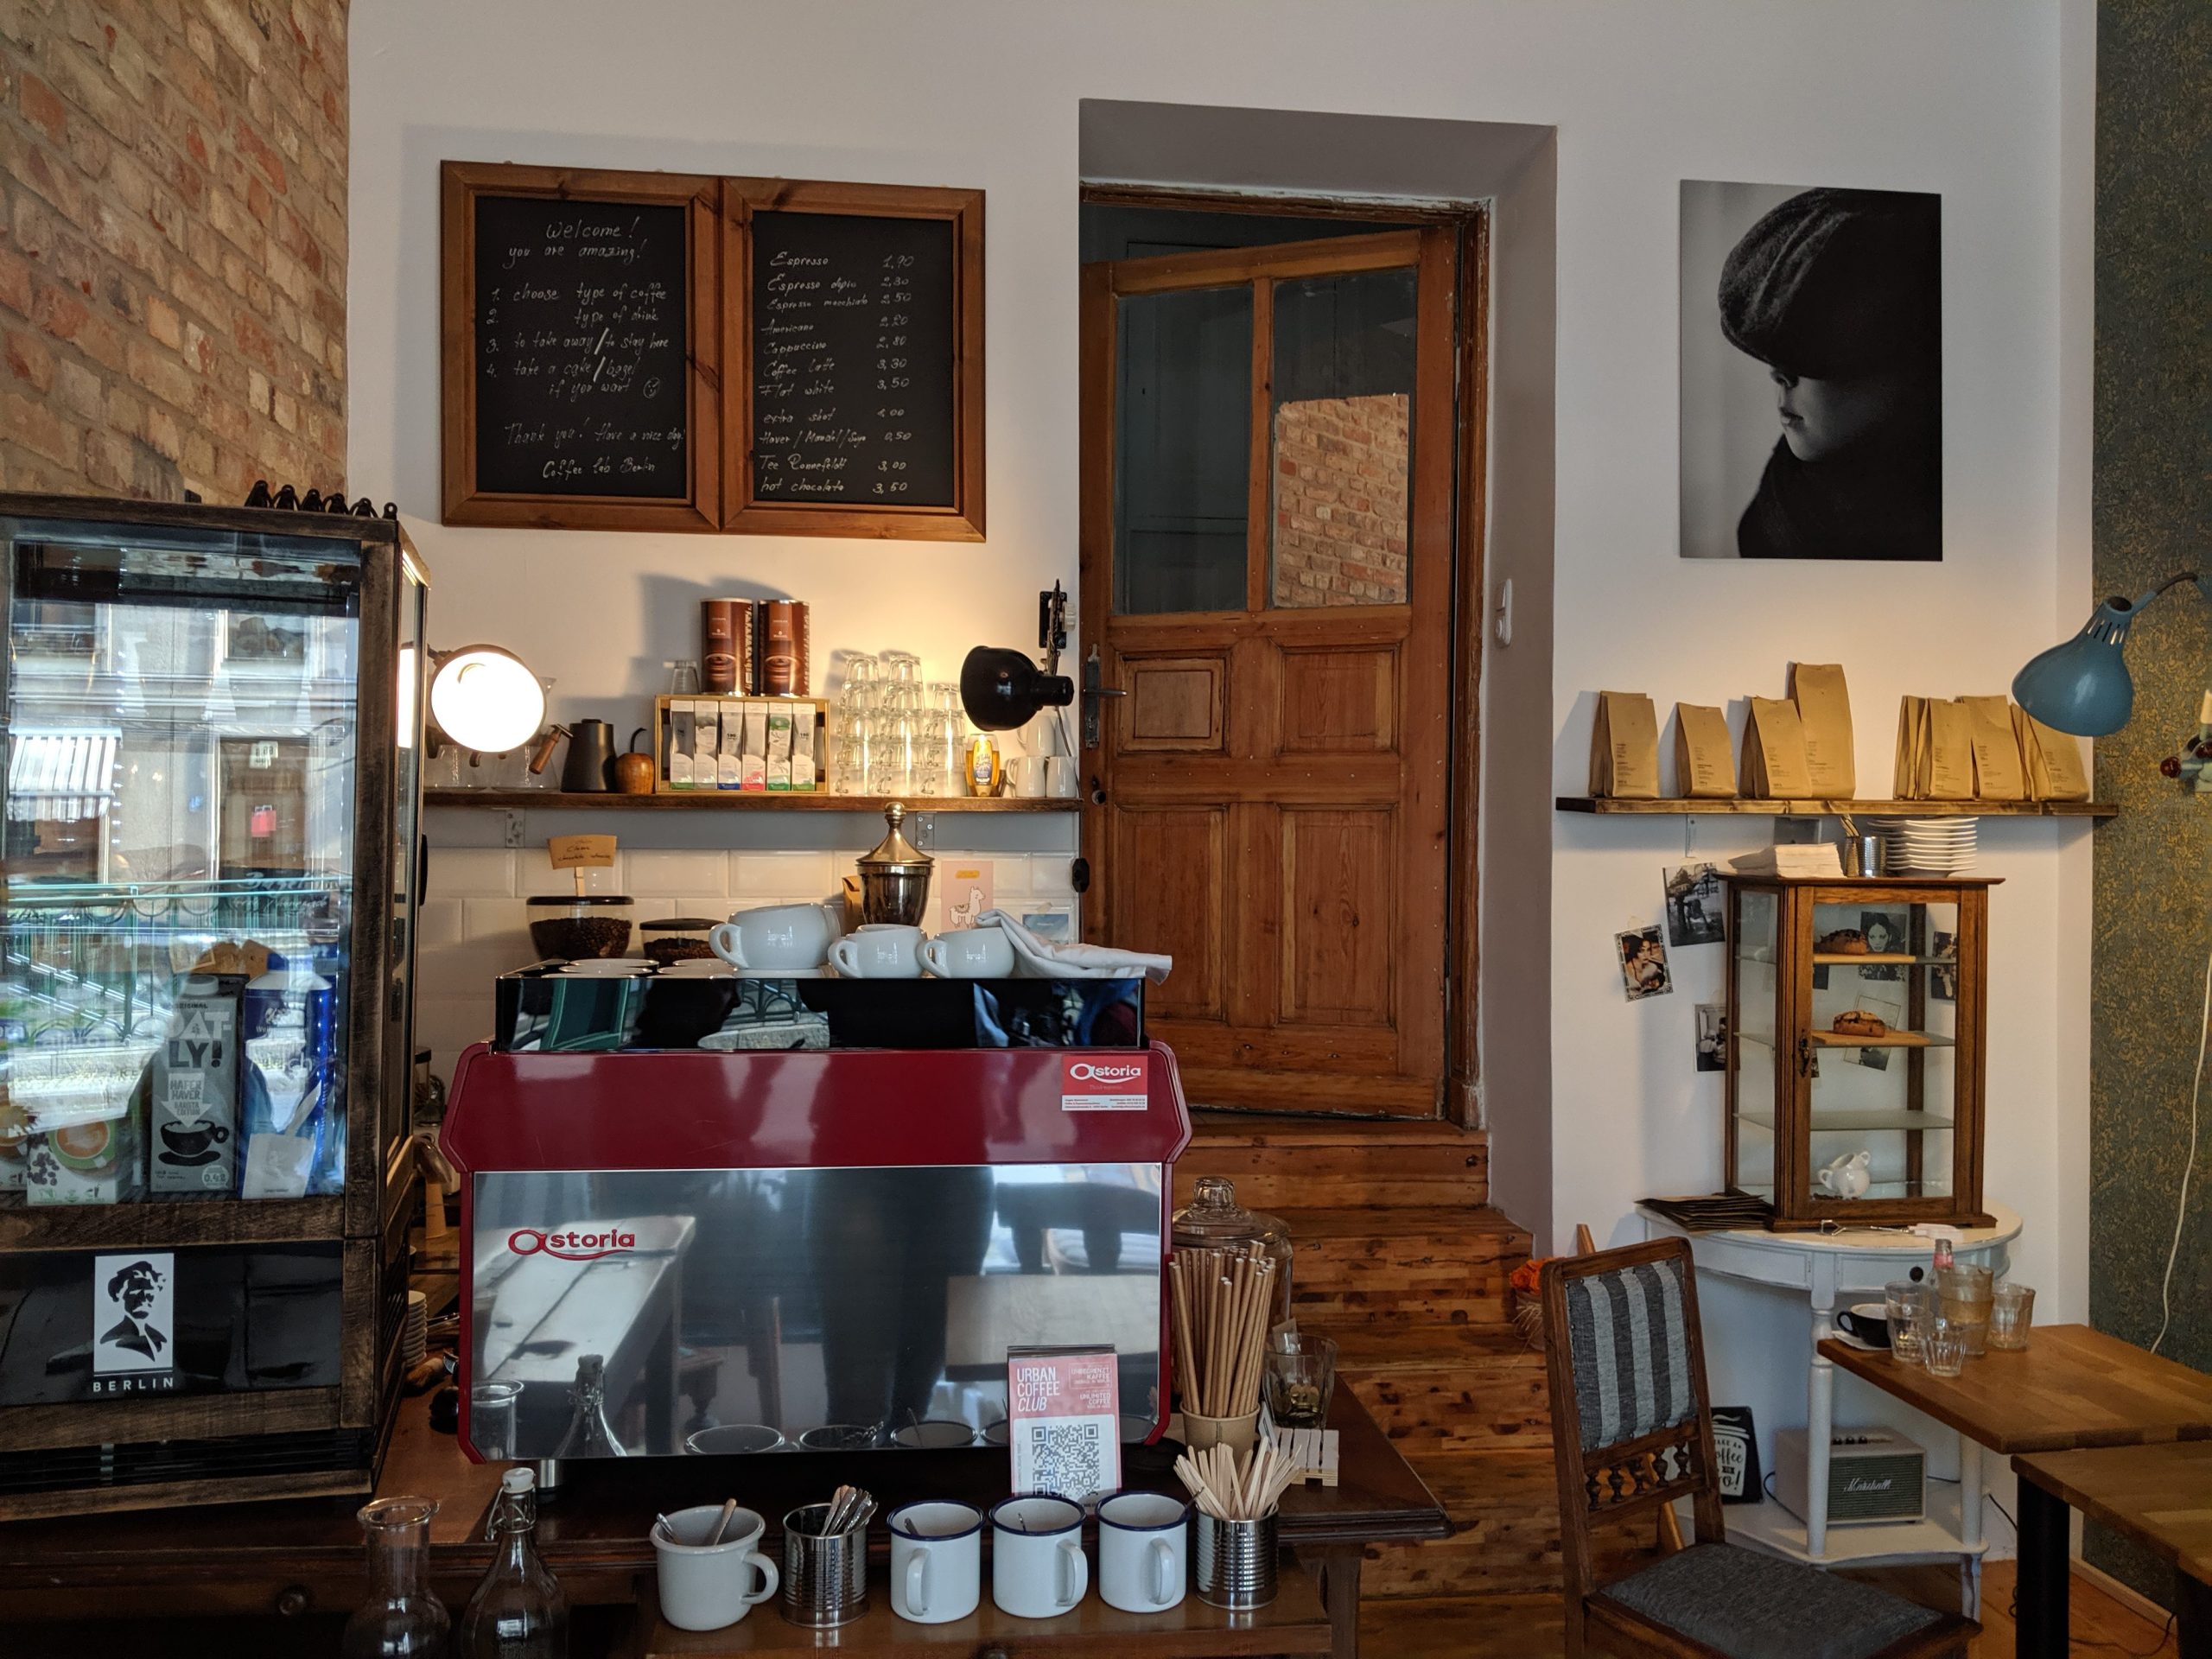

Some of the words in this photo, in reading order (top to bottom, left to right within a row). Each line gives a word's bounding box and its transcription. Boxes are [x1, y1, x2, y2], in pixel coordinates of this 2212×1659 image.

[544, 245, 564, 256] are
[770, 251, 829, 268] Espresso
[513, 283, 560, 301] choose
[576, 283, 605, 305] type
[613, 283, 627, 301] of
[630, 282, 667, 305] coffee
[767, 273, 821, 297] Espresso
[767, 298, 812, 313] Espresso
[575, 308, 604, 327] type
[612, 305, 627, 322] of
[760, 318, 814, 335] Americano
[532, 331, 557, 347] take
[563, 336, 594, 353] away
[620, 333, 645, 355] stay
[650, 333, 669, 349] here
[763, 341, 827, 359] Cappuccino
[513, 358, 539, 377] take
[563, 357, 591, 377] cake
[764, 359, 797, 380] Coffee
[759, 383, 794, 397] Flat
[804, 380, 835, 395] white
[763, 409, 794, 423] extra
[808, 407, 836, 422] shot
[505, 423, 545, 444] Thank
[594, 423, 622, 442] Have
[543, 459, 583, 481] Coffee
[620, 456, 655, 474] Berlin
[760, 454, 779, 470] Tee
[760, 477, 782, 493] hot
[791, 478, 844, 493] chocolate
[168, 1039, 222, 1068] LY!
[1016, 1367, 1057, 1382] URBAN
[92, 1377, 174, 1393] BERLIN
[1016, 1381, 1061, 1397] COFFEE
[1017, 1396, 1047, 1412] CLUB
[1715, 1447, 1744, 1465] offee
